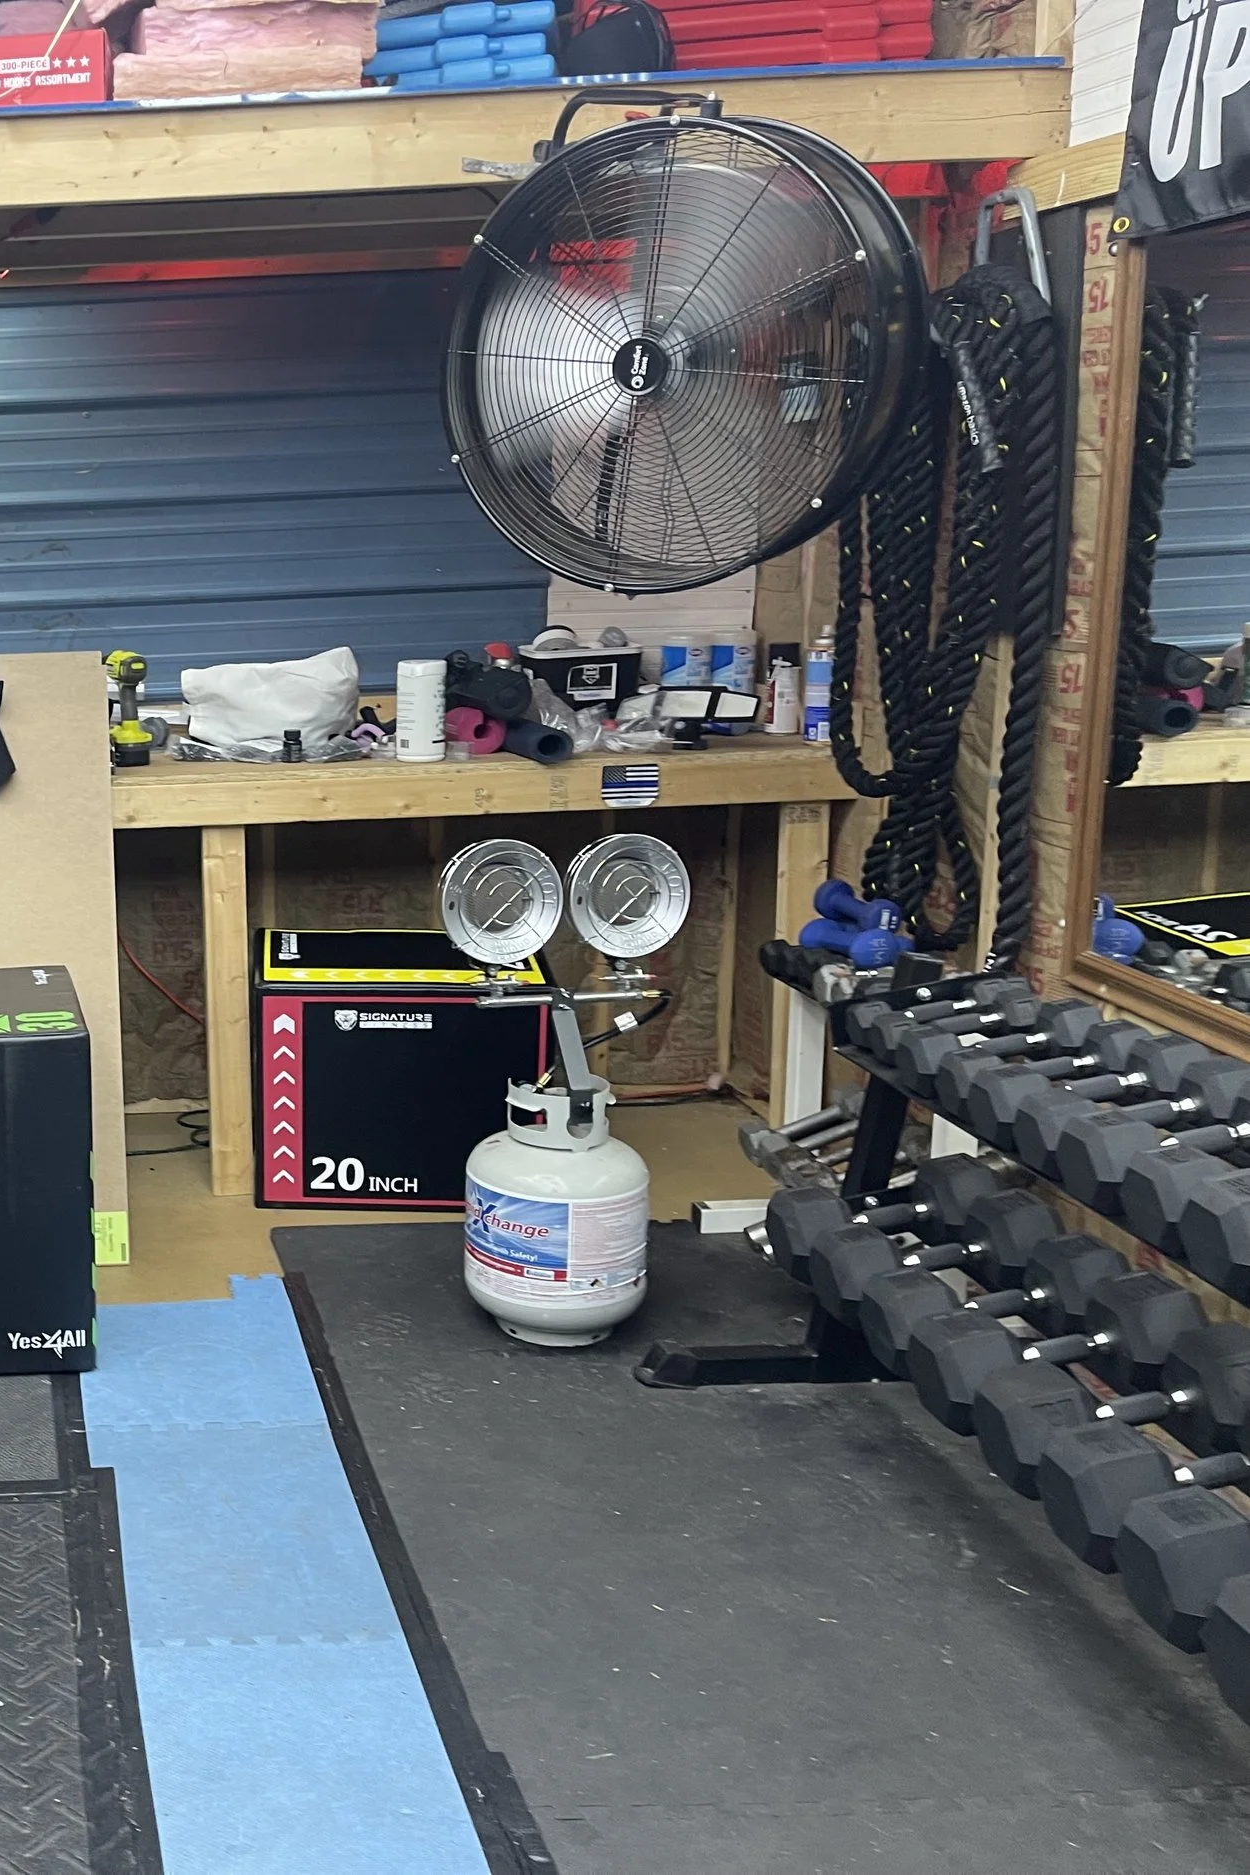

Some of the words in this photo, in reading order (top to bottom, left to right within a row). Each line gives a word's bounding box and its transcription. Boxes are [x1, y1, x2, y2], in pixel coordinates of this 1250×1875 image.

[1, 59, 48, 71] 300-PIECE
[35, 72, 91, 86] ASSORTMENT
[15, 1011, 78, 1032] 30
[359, 1012, 433, 1022] SIGNATURE
[310, 1156, 365, 1192] 20
[368, 1176, 418, 1193] INCH
[7, 1329, 86, 1359] Yes4All
